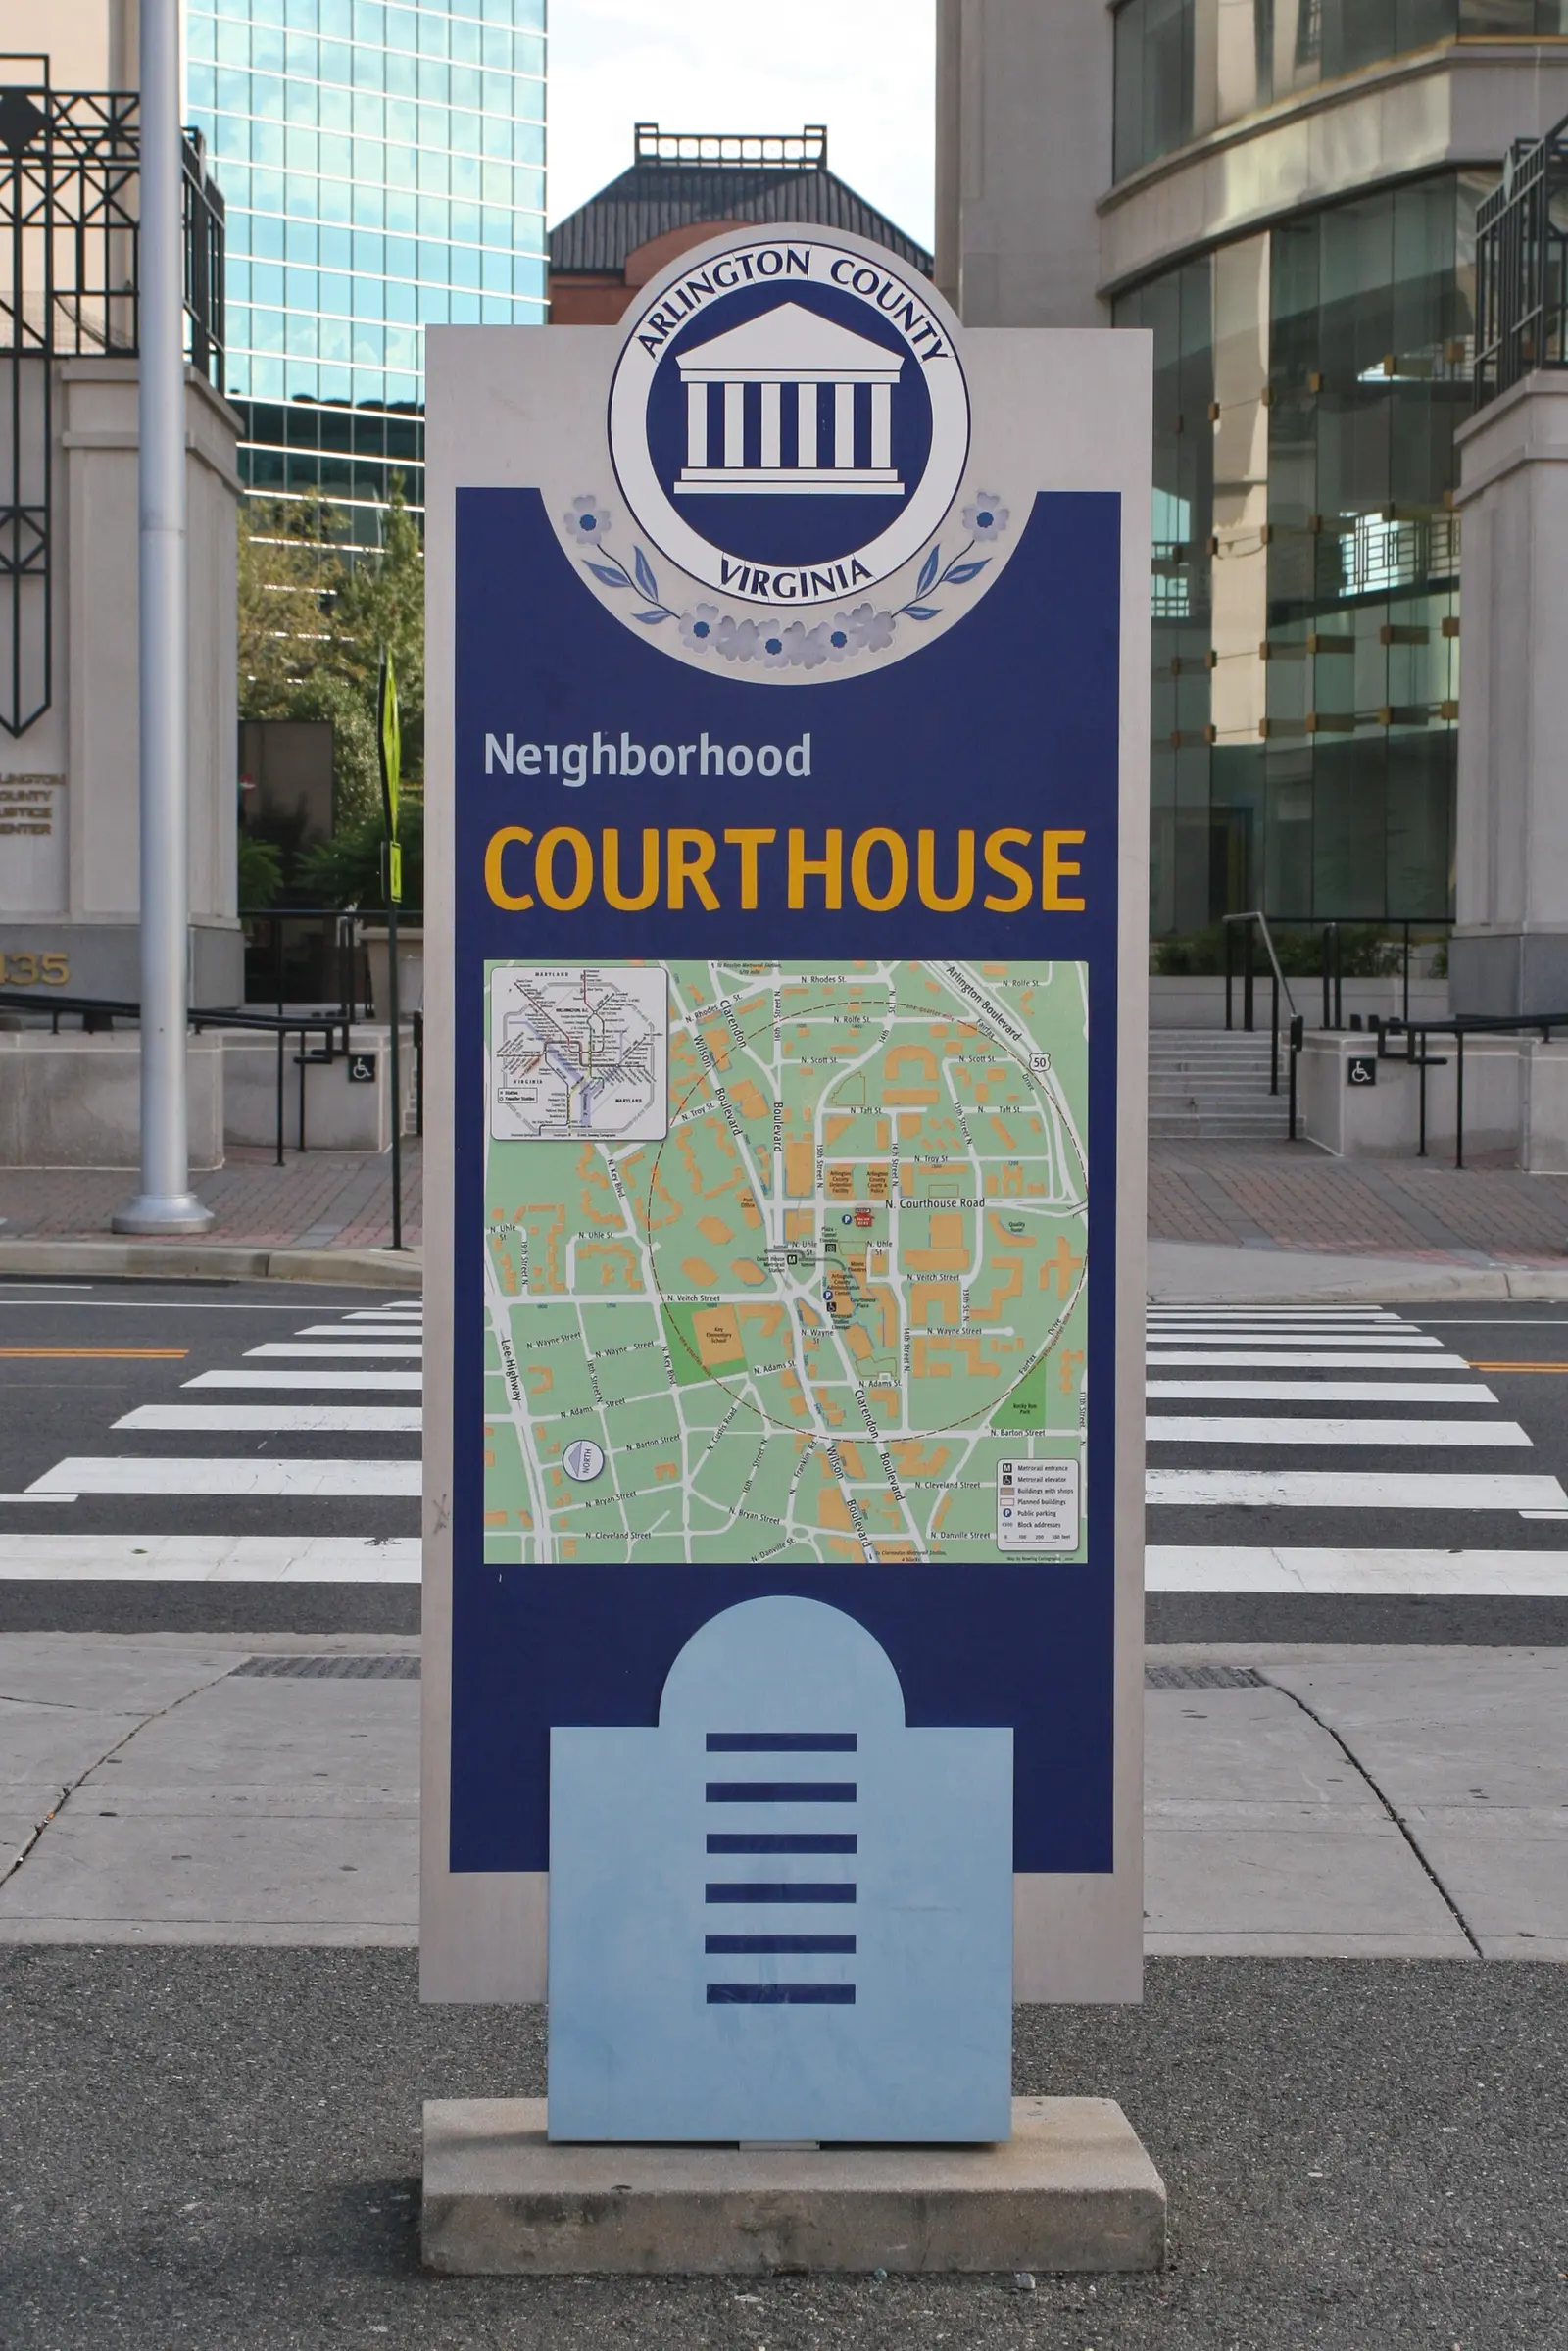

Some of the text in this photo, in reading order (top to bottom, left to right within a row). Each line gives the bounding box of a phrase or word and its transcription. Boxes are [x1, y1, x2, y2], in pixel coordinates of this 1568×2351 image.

[636, 249, 950, 363] ARLINGTON COUNTY
[719, 558, 874, 598] VIRGINIA
[485, 732, 812, 787] Neighborhood
[484, 825, 1088, 912] COURTHOUSE
[694, 1004, 718, 1019] Rhodes
[946, 966, 1022, 1042] Arlington Boulevard
[719, 999, 747, 1049] Clarendon
[976, 1019, 1035, 1091] Fairfax Drive
[1034, 1057, 1046, 1068] 50
[694, 1034, 743, 1136] Wilson Boulevard
[690, 1106, 706, 1118] Troy
[773, 1102, 784, 1152] Boulevard
[958, 1116, 969, 1138] Street
[610, 1168, 618, 1182] Key
[885, 1198, 985, 1209] N. Courthouse Road
[500, 1224, 515, 1233] Uhle
[536, 1331, 581, 1348] Wayne Street
[810, 1329, 834, 1338] Wayne
[605, 1341, 655, 1357] Wayne Street
[1019, 1319, 1062, 1375] Fairfax Drive
[500, 1339, 521, 1401] Lee Highway
[763, 1362, 786, 1372] Adams
[591, 1374, 601, 1396] Street
[570, 1398, 625, 1417] Adams Street
[855, 1390, 879, 1439] Clarendon
[711, 1407, 738, 1443] Custis Road
[636, 1434, 681, 1450] Barton Street
[582, 1448, 592, 1473] NORTH
[742, 1448, 764, 1494] 16th Street
[794, 1452, 810, 1478] Franklin
[880, 1452, 906, 1501] Boulevard
[595, 1491, 637, 1507] Bryan Street
[827, 1445, 872, 1548] Wilson Boulevard
[739, 1509, 780, 1525] Bryan Street
[760, 1543, 786, 1558] Danville
